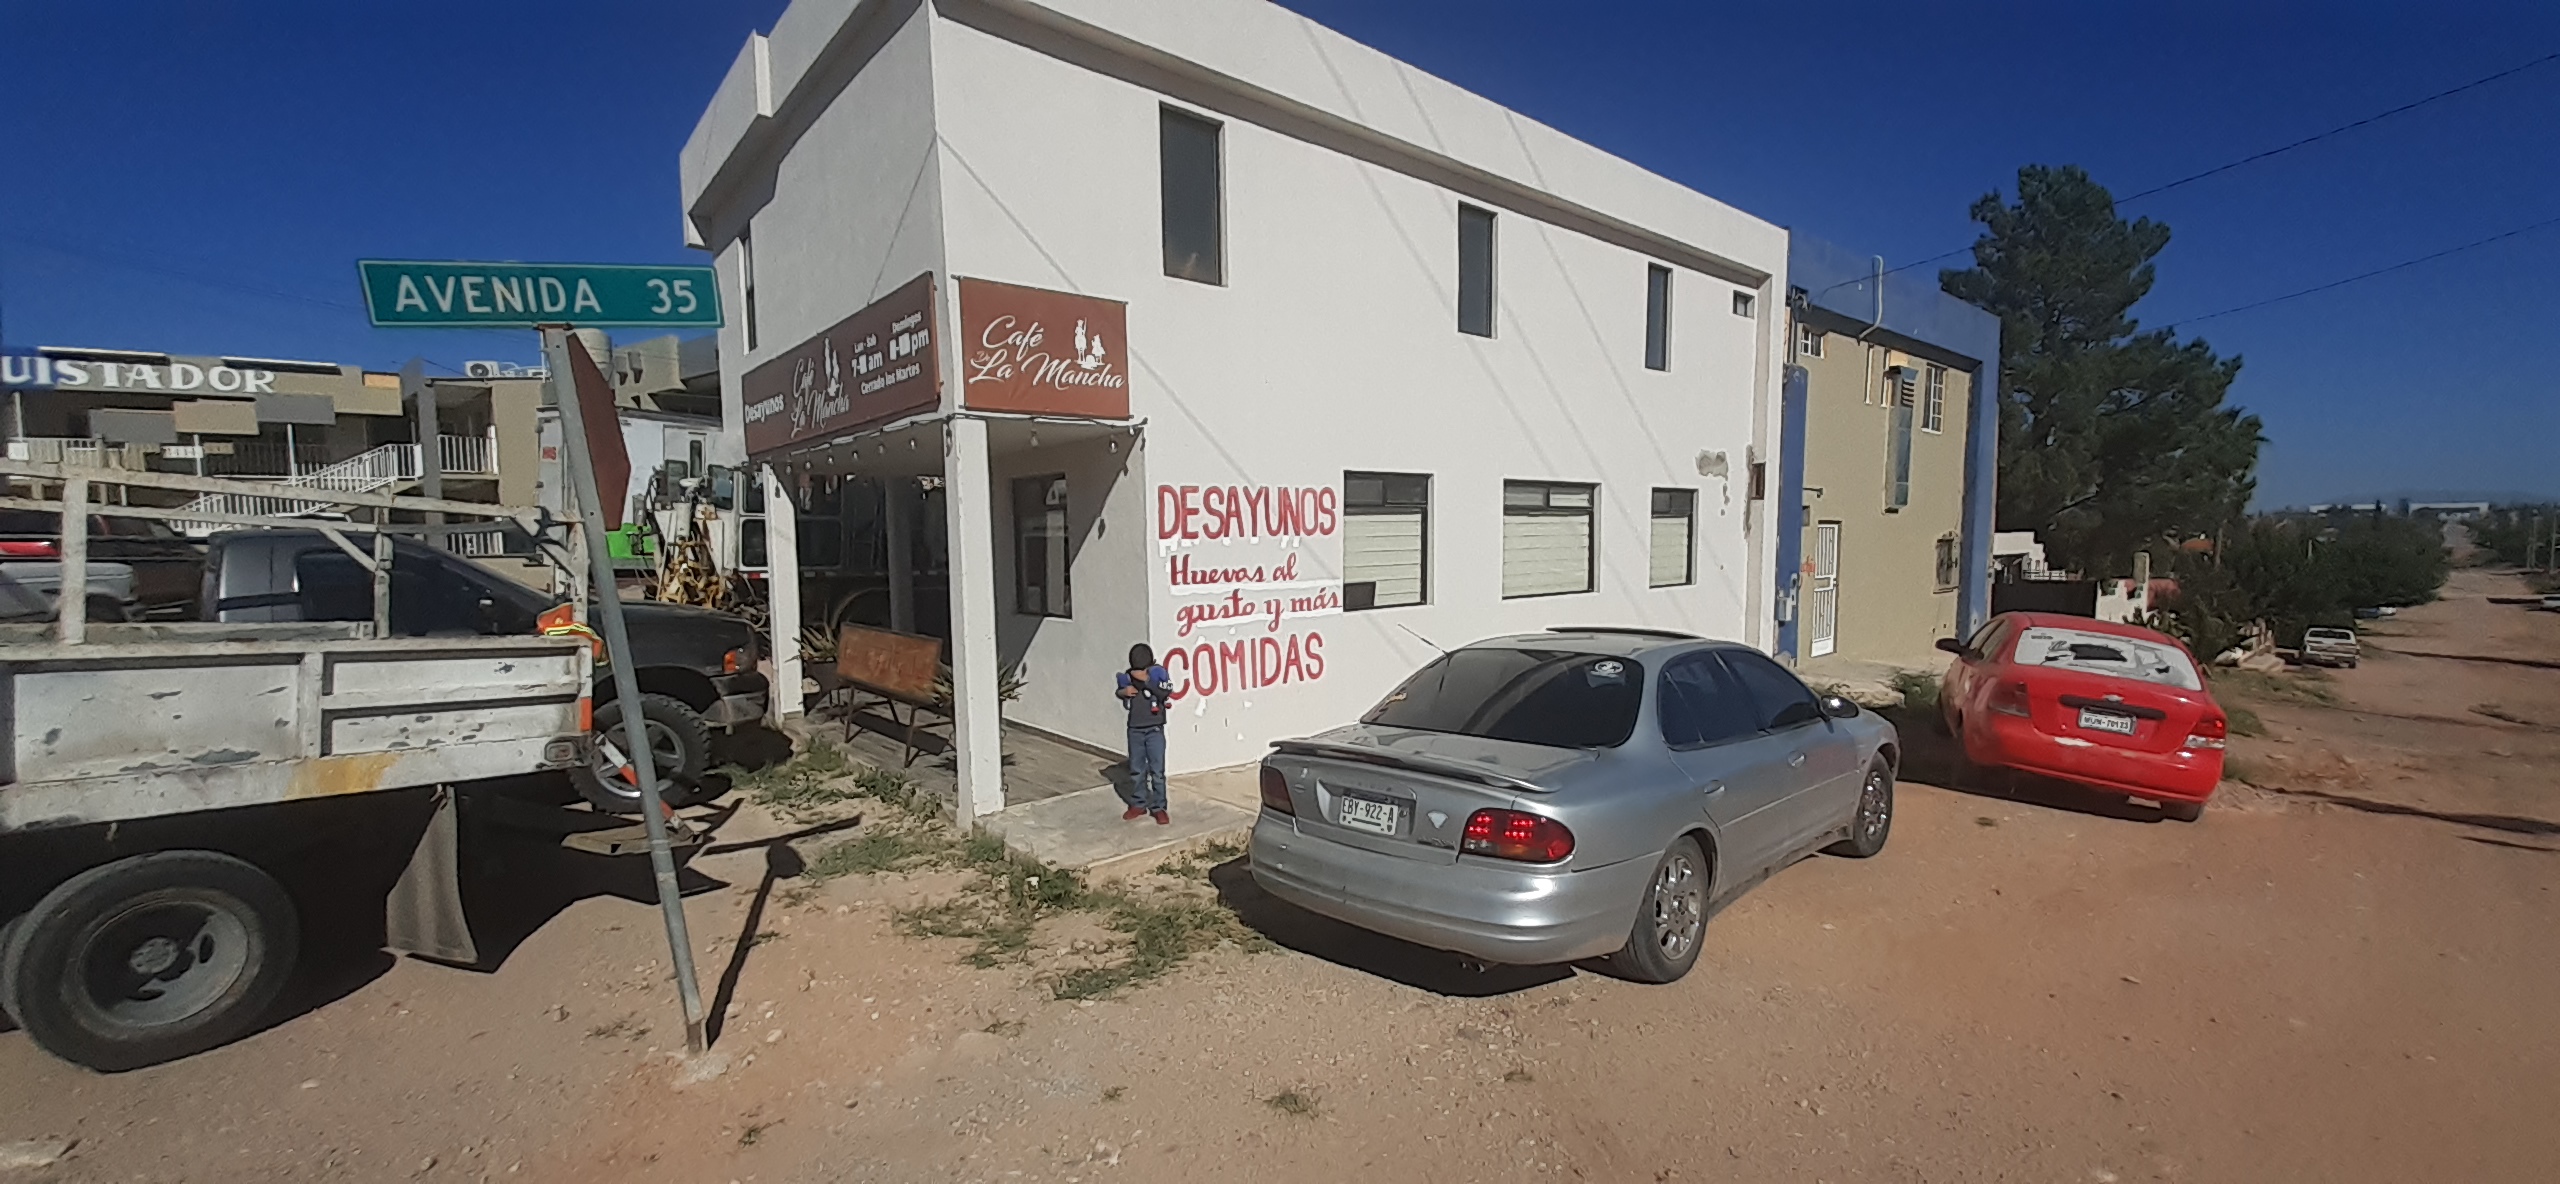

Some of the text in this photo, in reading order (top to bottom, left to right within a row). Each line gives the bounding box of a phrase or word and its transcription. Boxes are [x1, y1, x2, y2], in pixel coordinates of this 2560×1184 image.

[395, 274, 698, 314] AVENIDA 35
[911, 328, 929, 356] pm
[982, 315, 1044, 362] Café
[1, 355, 276, 394] UISTADOR
[968, 349, 1125, 391] La Mancha
[1157, 484, 1337, 540] DESAYUNOS
[1272, 552, 1299, 582] al
[1176, 587, 1342, 637] gusto y más
[1162, 632, 1325, 700] COMIDAS
[1342, 797, 1394, 824] EBY-922-A
